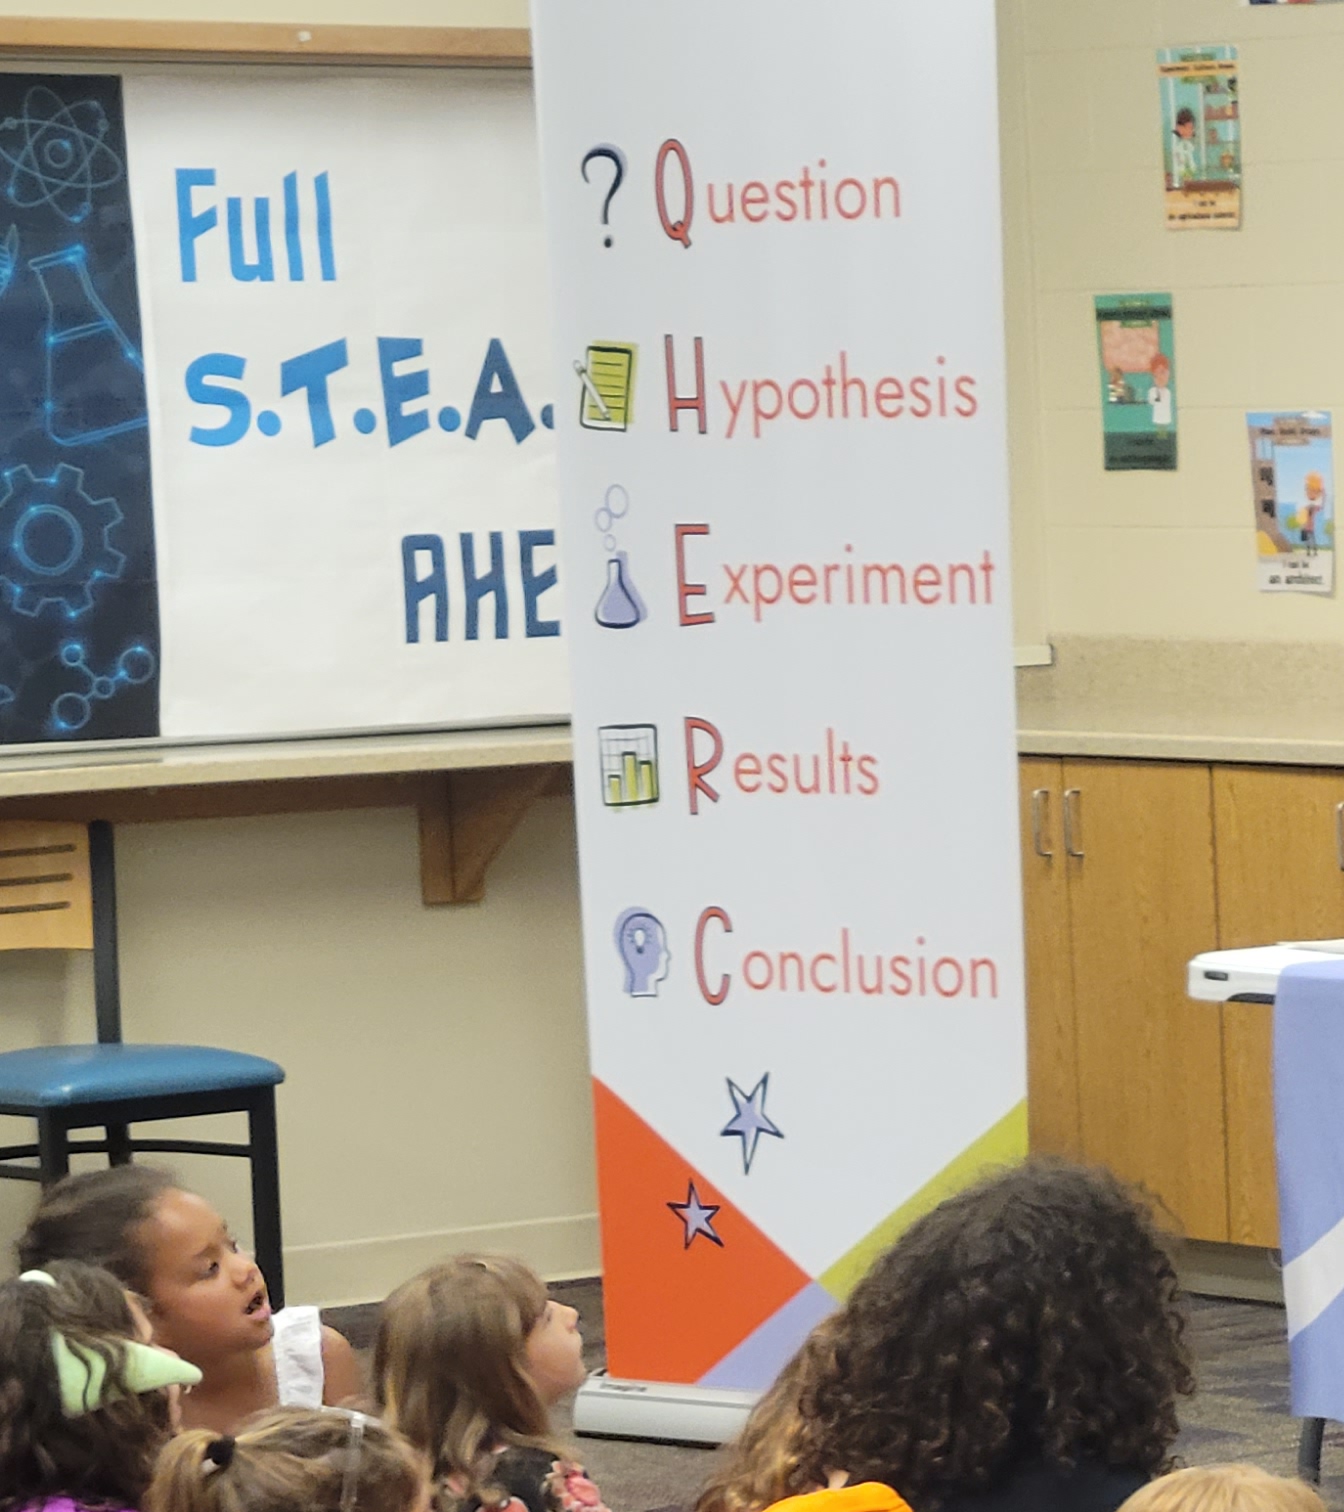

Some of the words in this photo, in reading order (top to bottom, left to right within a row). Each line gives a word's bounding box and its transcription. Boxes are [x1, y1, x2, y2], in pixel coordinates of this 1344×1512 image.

[175, 168, 337, 283] Full
[655, 138, 901, 250] Question
[664, 333, 979, 440] Hypothesis
[674, 522, 996, 626] Experiment
[684, 716, 881, 816] Results
[693, 905, 1000, 1006] Conclusion
